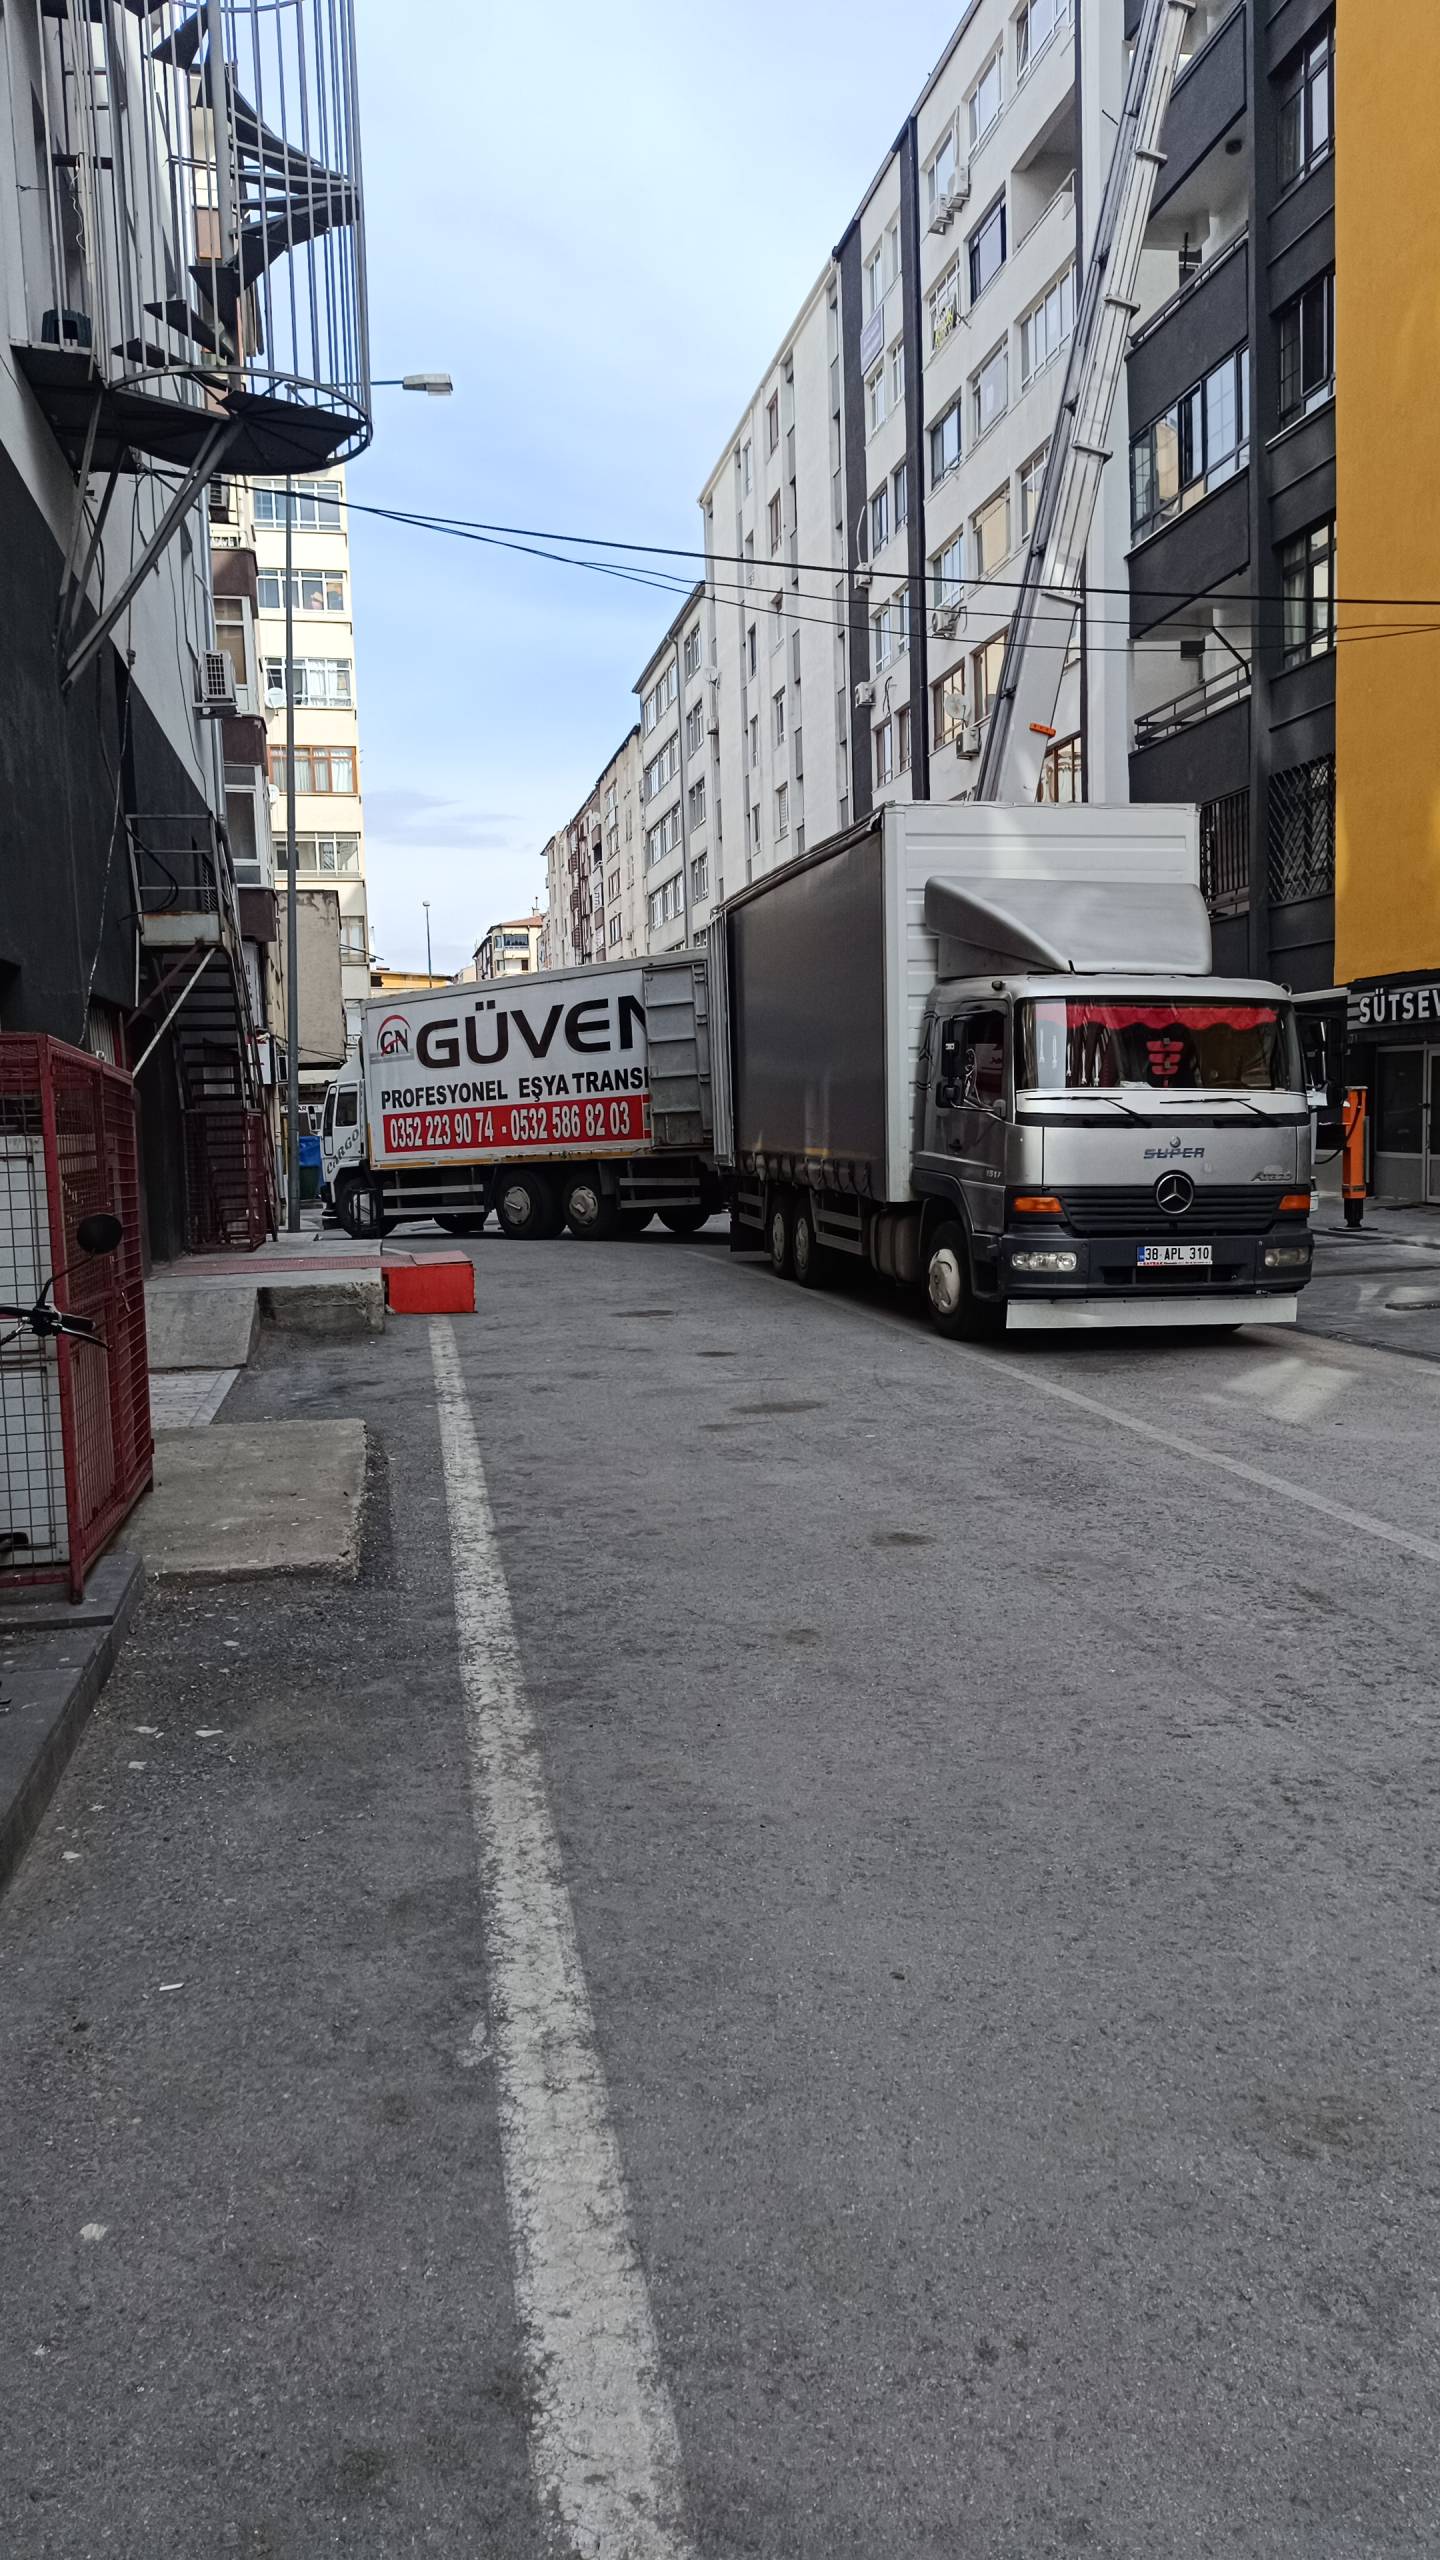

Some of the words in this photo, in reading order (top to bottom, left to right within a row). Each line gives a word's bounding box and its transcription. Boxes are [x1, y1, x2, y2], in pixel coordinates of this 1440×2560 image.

[381, 1079, 509, 1110] PROFESYONEL
[518, 1074, 569, 1102] EŞYA
[390, 1116, 423, 1148] 0352
[425, 1114, 451, 1146] 223
[454, 1112, 472, 1144] 90
[475, 1110, 494, 1142] 74
[510, 1107, 548, 1141] 0532
[552, 1104, 581, 1139] 586
[585, 1103, 606, 1137] 82
[609, 1101, 630, 1135] 03
[1145, 1247, 1159, 1261] 38
[1164, 1247, 1185, 1261] APL
[1189, 1247, 1210, 1260] 310
